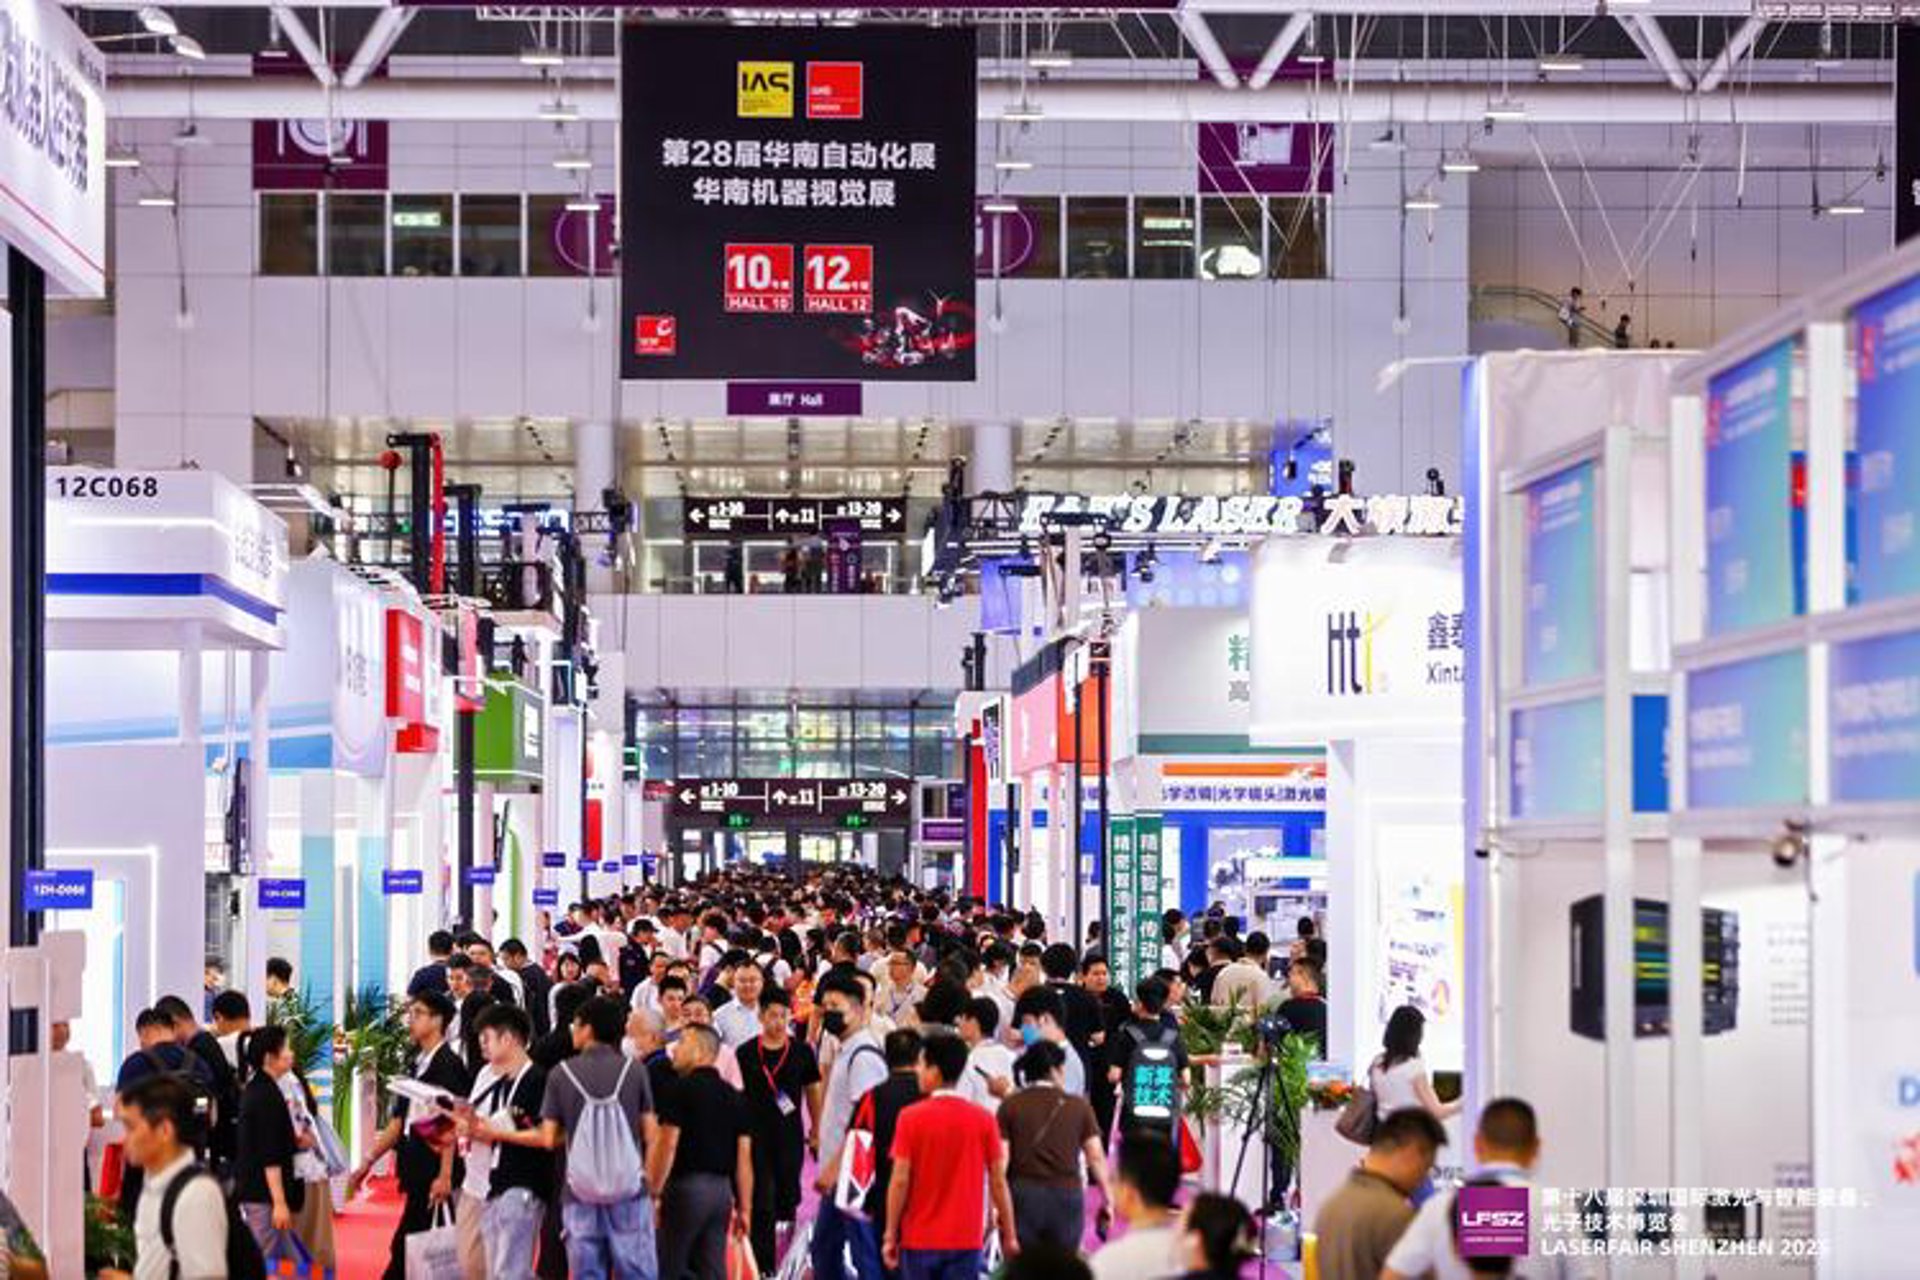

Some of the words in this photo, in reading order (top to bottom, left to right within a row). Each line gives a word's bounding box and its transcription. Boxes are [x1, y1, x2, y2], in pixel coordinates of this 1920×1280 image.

[661, 138, 937, 169] 第28届华南自动化展
[693, 178, 896, 207] 华南机器视觉展
[728, 298, 769, 310] HALL
[773, 298, 789, 310] 10
[808, 298, 848, 310] HALL
[852, 298, 867, 311] 12
[56, 476, 158, 498] 12C068
[850, 782, 887, 798] 13-20
